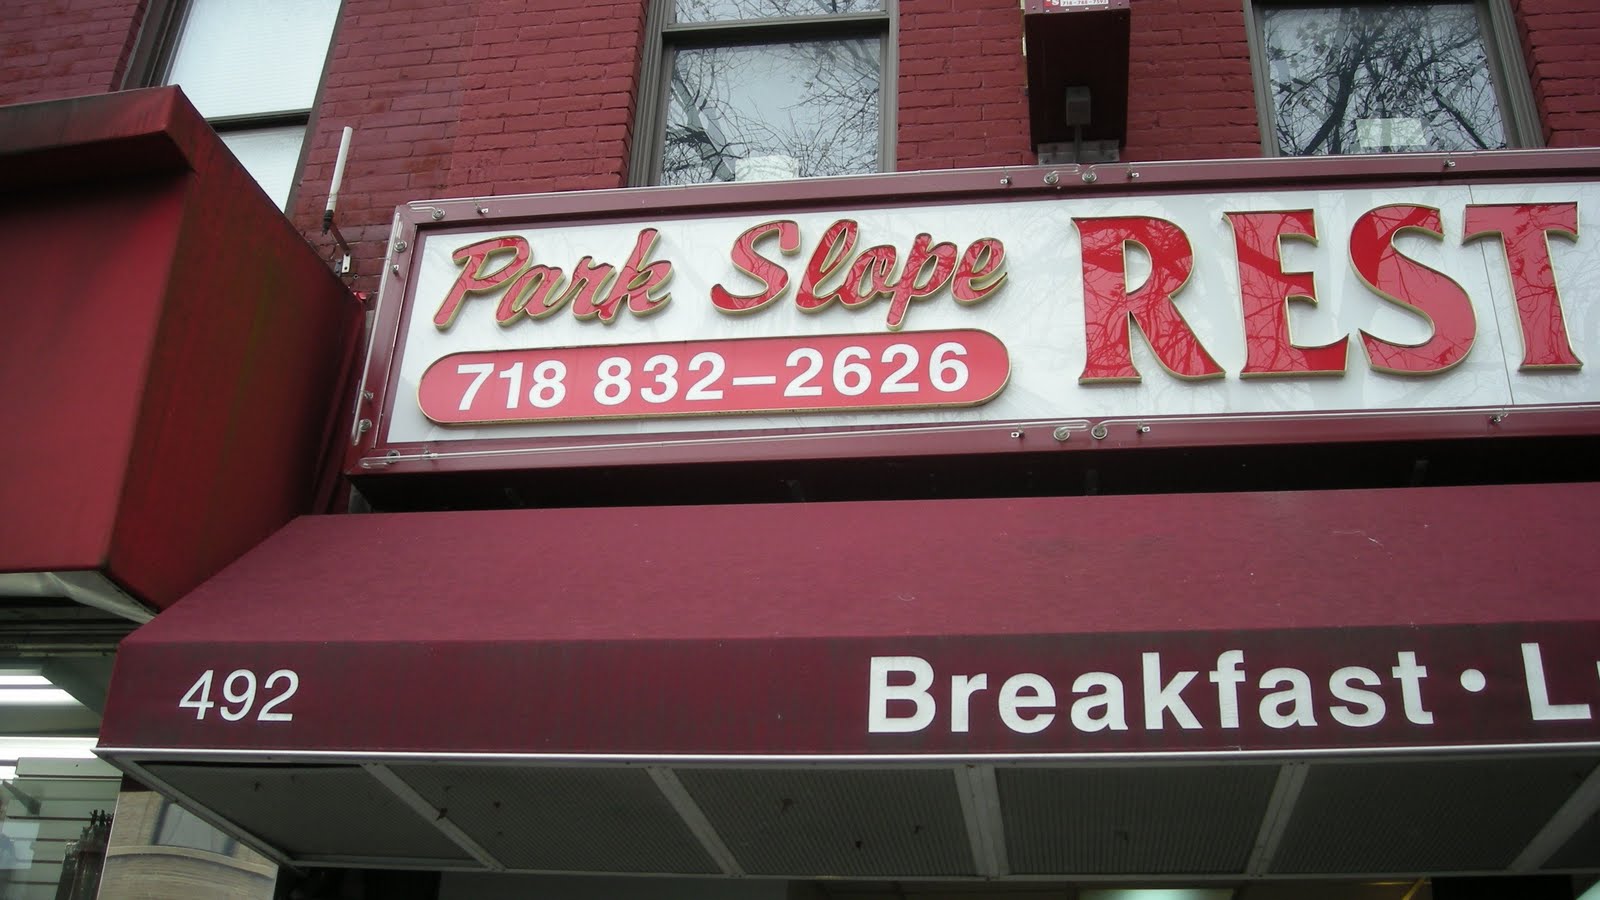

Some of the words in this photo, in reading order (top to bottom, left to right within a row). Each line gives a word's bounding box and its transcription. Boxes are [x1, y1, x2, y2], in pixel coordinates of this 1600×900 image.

[433, 227, 674, 331] Park
[710, 218, 1008, 331] Slope
[1071, 201, 1584, 386] REST
[456, 359, 567, 411] 718
[179, 669, 299, 722] 492
[868, 650, 1434, 734] Breakfast
[1521, 642, 1600, 721] L
